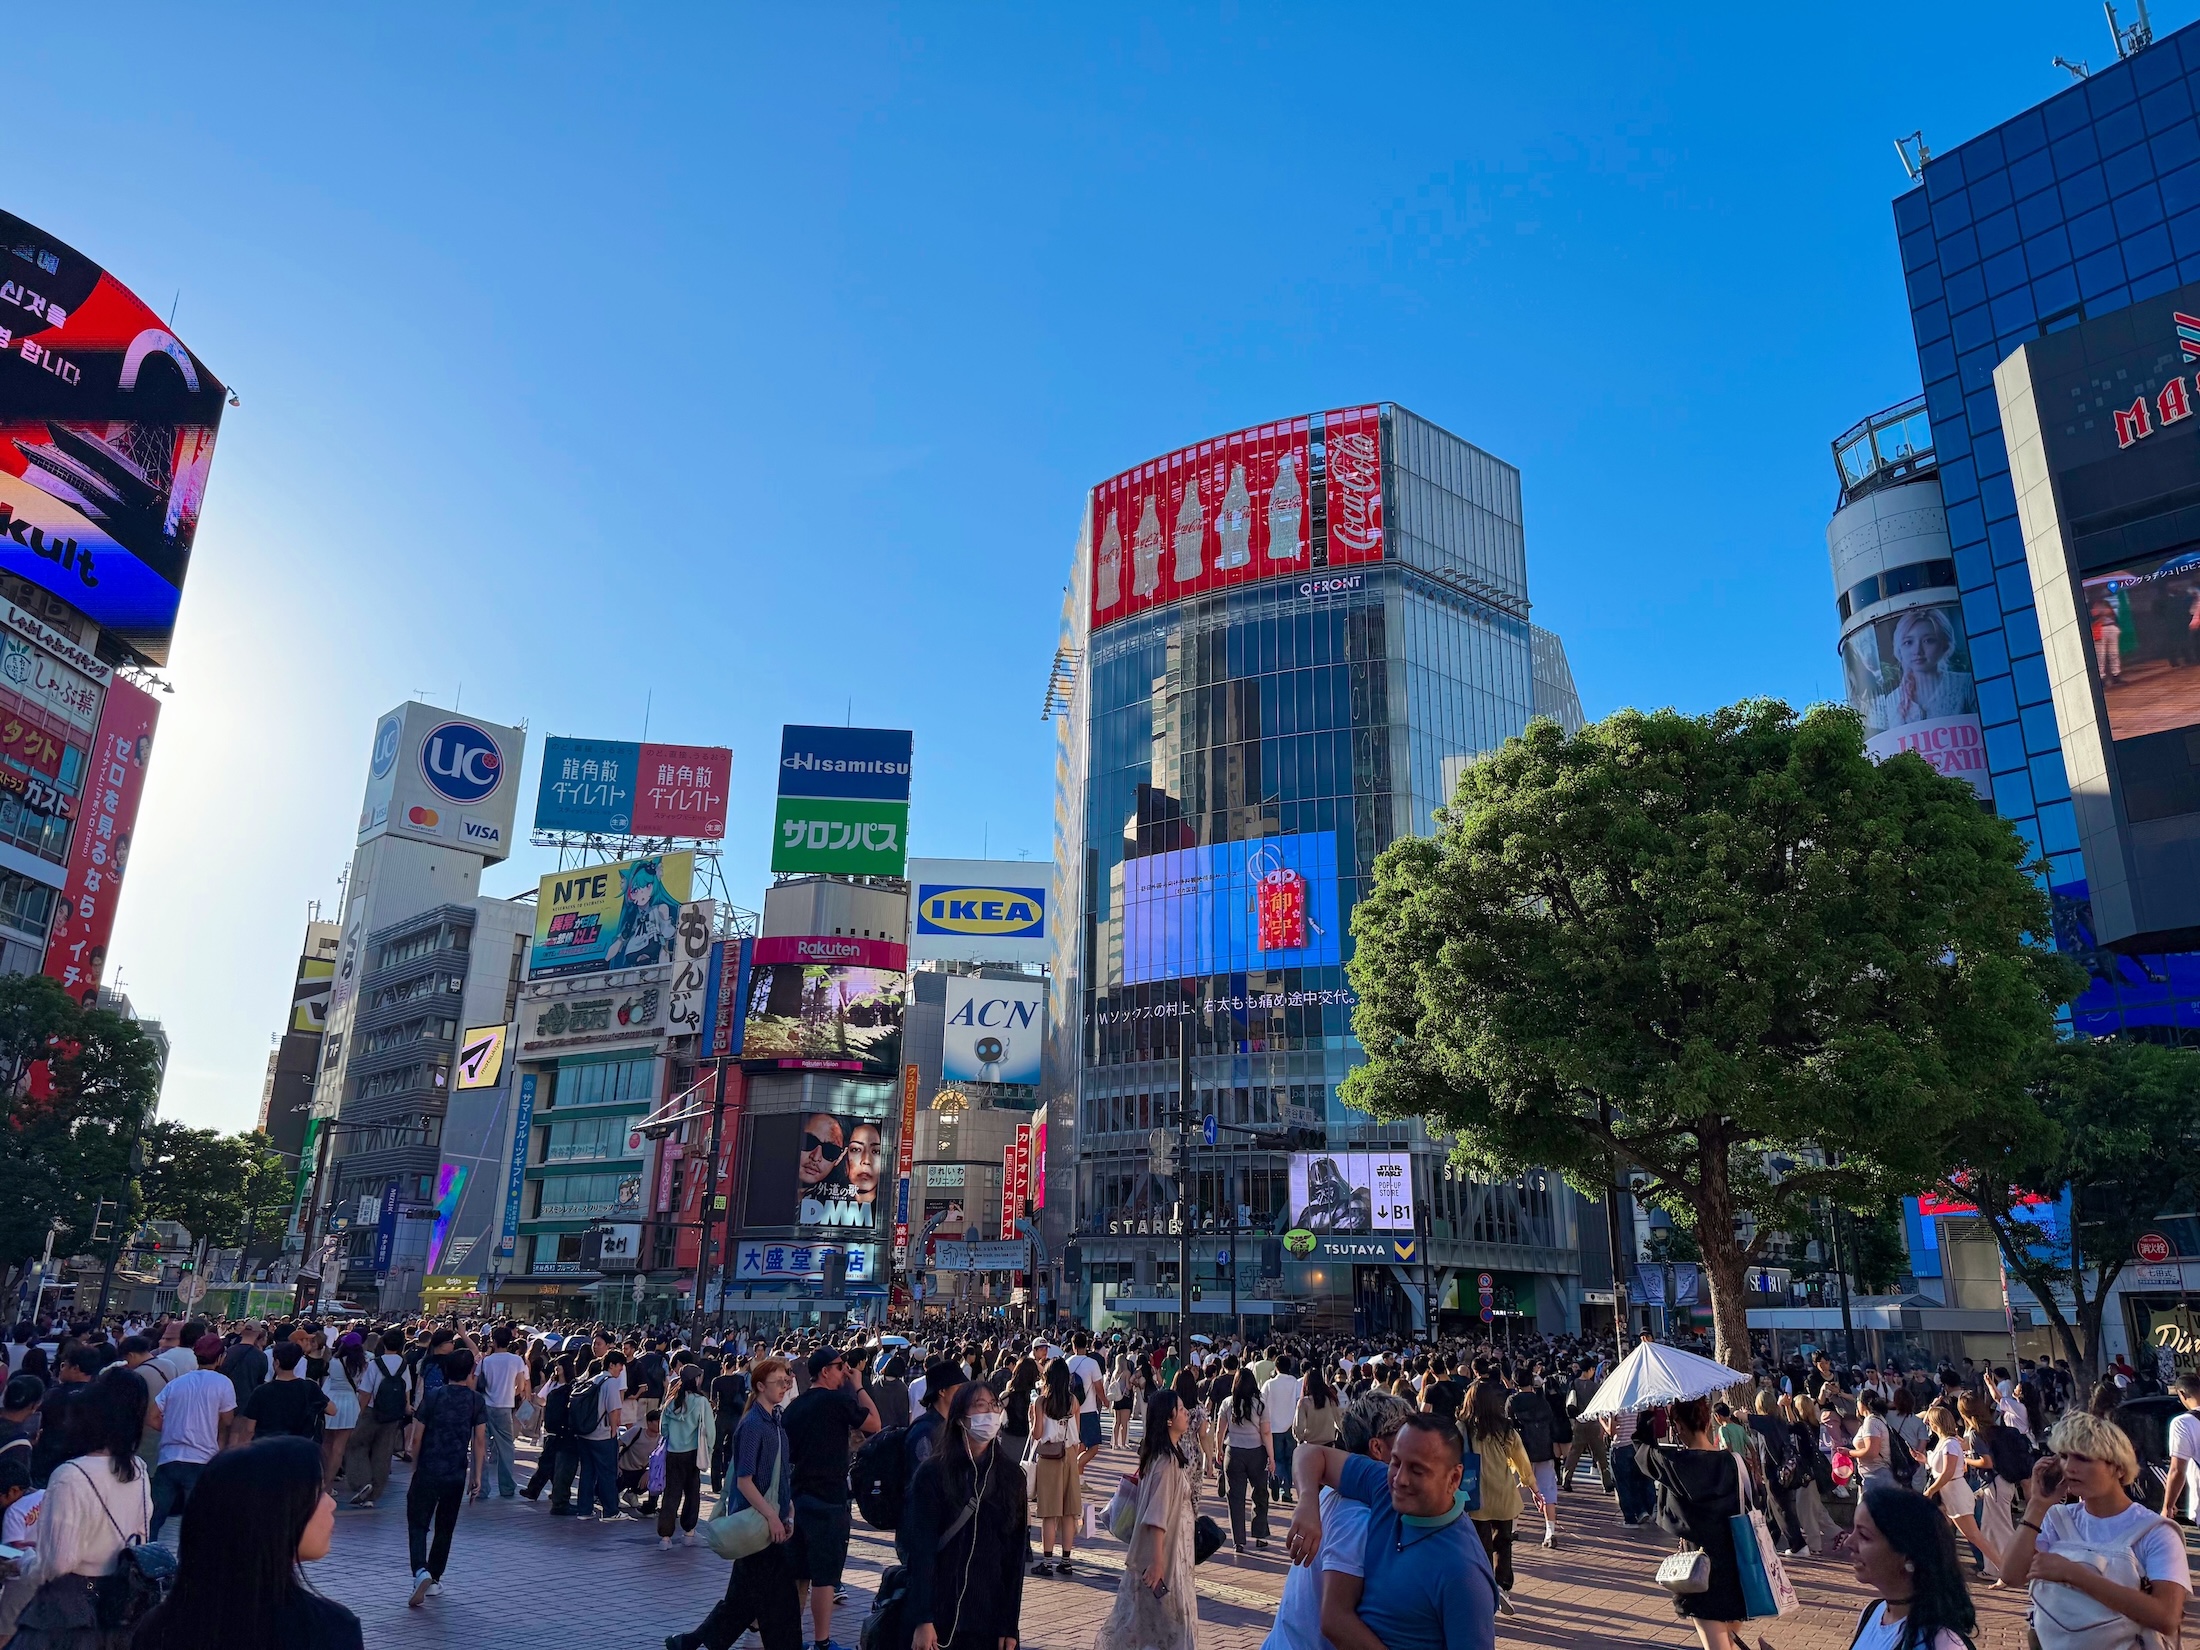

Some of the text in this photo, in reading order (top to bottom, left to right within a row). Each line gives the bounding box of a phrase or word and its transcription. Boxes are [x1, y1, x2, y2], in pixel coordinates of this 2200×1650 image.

[2113, 372, 2200, 449] MA
[1331, 430, 1377, 550] Coca-Cola
[2120, 568, 2174, 587] バングラデシュ
[9, 606, 109, 678] しゃぶしゃぶバイキング
[34, 661, 95, 715] しゃぶ葉
[3, 719, 57, 763] タクト
[375, 730, 396, 763] UC
[1897, 725, 1978, 752] LUCID
[430, 737, 494, 785] UC
[562, 758, 619, 783] 龍角散
[782, 753, 908, 775] Hisamitsu
[657, 763, 713, 789] 龍角散
[24, 780, 70, 816] ガスト
[552, 782, 626, 807] ダイレクト
[647, 787, 721, 813] ダイレクト
[464, 822, 499, 842] VISA
[783, 820, 898, 852] サロンパス
[553, 874, 608, 905] NTE
[931, 900, 1034, 922] IKEA
[1270, 892, 1292, 937] 御守
[798, 941, 860, 958] Rakuten
[670, 904, 709, 1031] もんじゃ
[948, 997, 1040, 1029] ACN
[329, 1044, 340, 1057] 7F
[480, 1040, 501, 1074] matsukiyo
[904, 1067, 916, 1133] クスリのことなら
[1285, 1107, 1312, 1122] 渋谷駅前
[512, 1093, 533, 1187] サマーフルーツギフト
[938, 1167, 964, 1175] れいわ
[1016, 1132, 1029, 1189] カラオケ
[817, 1182, 860, 1198] 外道の歌
[929, 1178, 964, 1186] クリニック
[800, 1199, 874, 1228] DMM
[1003, 1190, 1014, 1240] カラオケ
[1394, 1205, 1410, 1219] B1
[1324, 1244, 1385, 1255] TSUTAYA
[2141, 1243, 2166, 1254] 消火栓
[1750, 1275, 1782, 1293] SEBU
